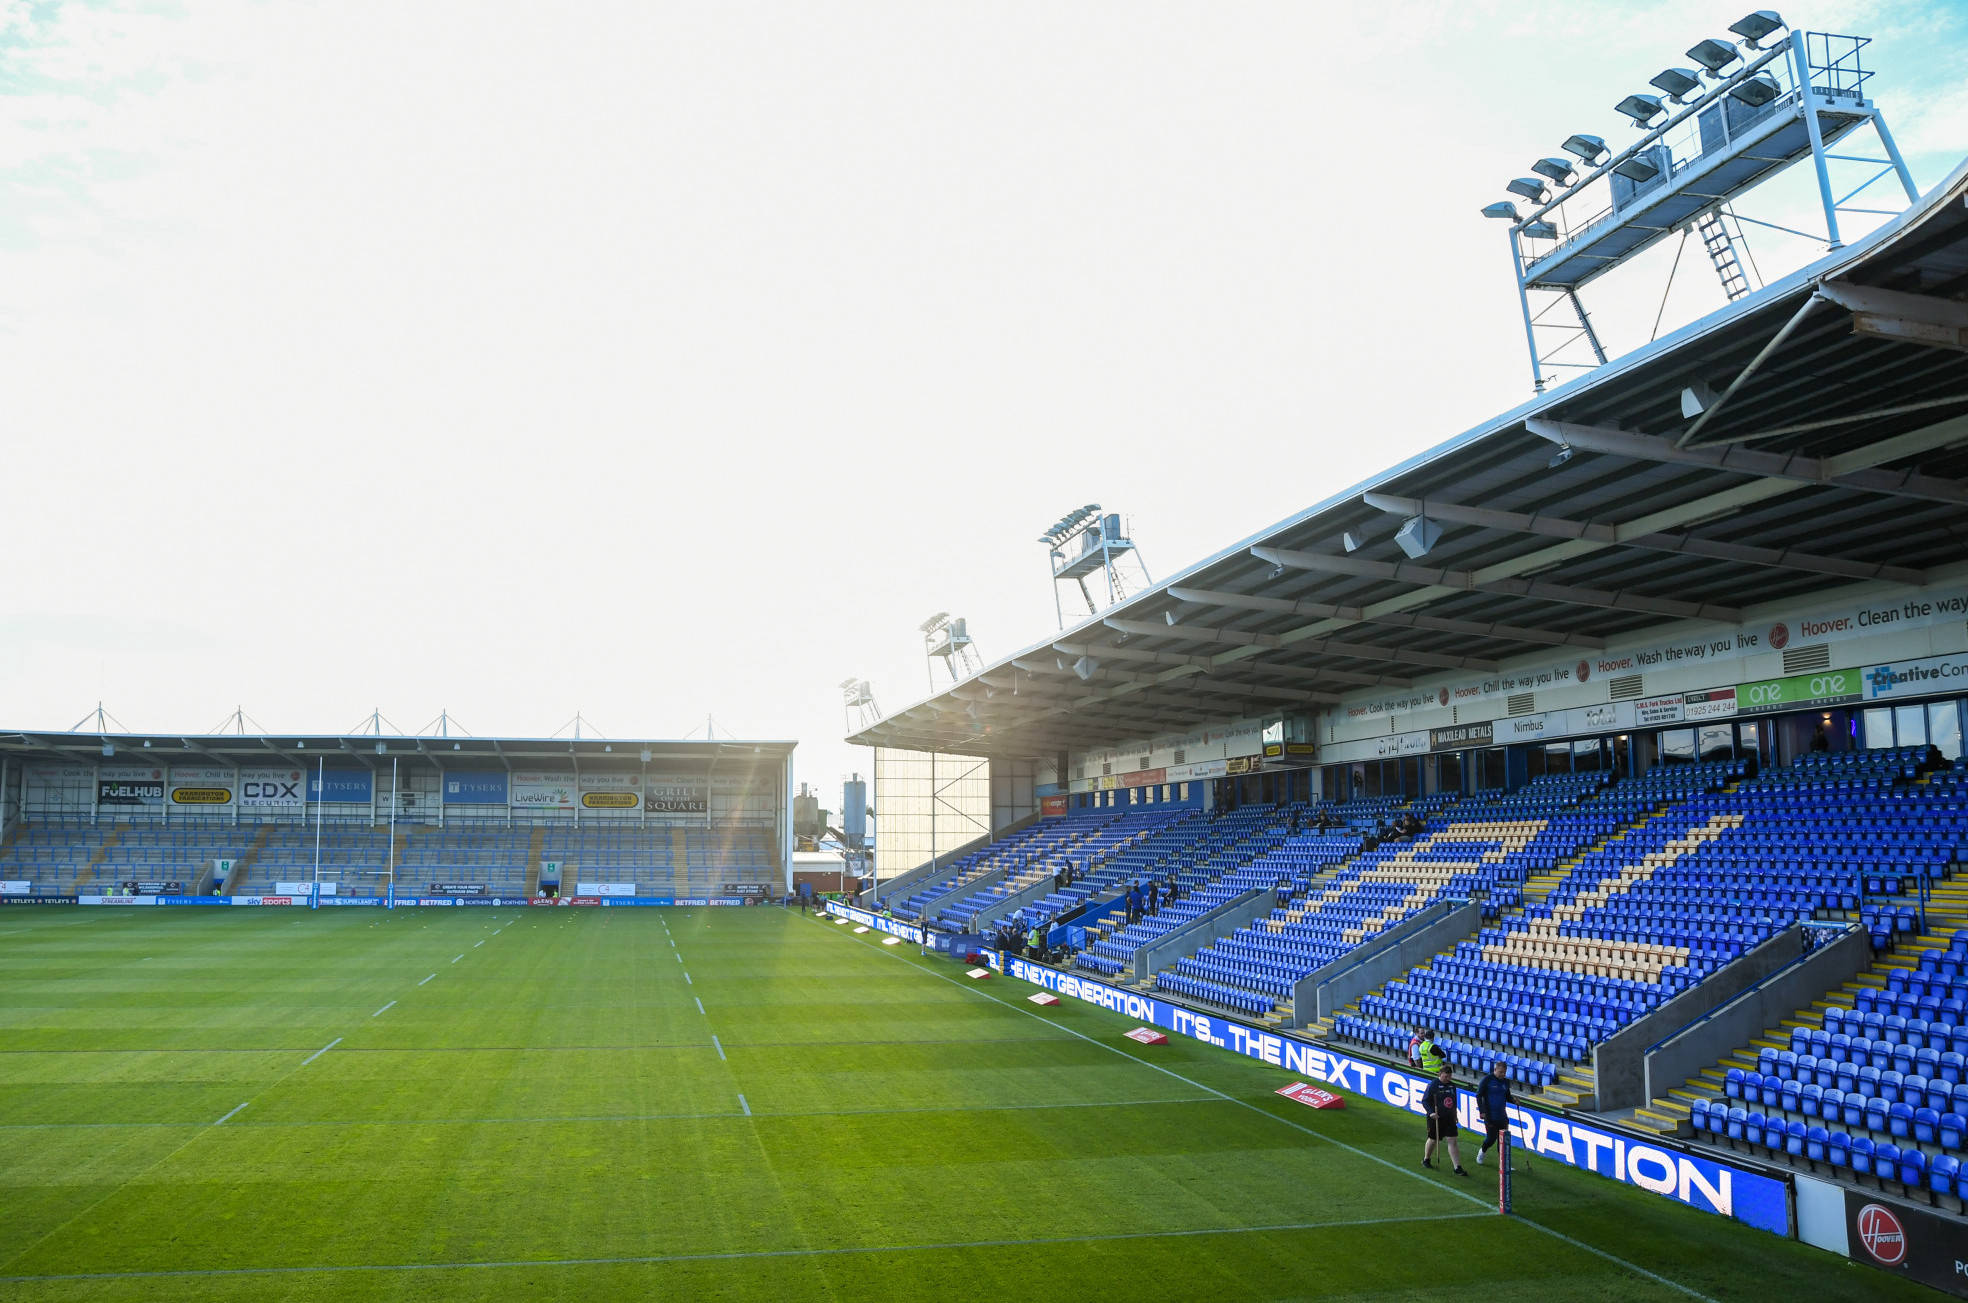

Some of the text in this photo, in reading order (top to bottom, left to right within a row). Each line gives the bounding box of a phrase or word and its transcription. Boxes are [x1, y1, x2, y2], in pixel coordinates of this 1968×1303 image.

[1801, 617, 1854, 637] Hoover.
[1858, 608, 1900, 626] Clean
[1904, 602, 1931, 619] the
[1936, 597, 1968, 614] way
[1598, 658, 1633, 673] Hoover.
[1636, 649, 1663, 665] Wash
[1666, 647, 1683, 661] the
[1684, 644, 1706, 659] way
[1710, 639, 1731, 656] you
[1737, 633, 1758, 649] live
[1455, 686, 1481, 698] Hoover.
[1483, 680, 1500, 694] Chill
[1502, 678, 1515, 690] the
[1519, 676, 1533, 689] way
[1535, 673, 1552, 686] you
[1554, 668, 1569, 680] live
[1750, 675, 1846, 704] one one
[1369, 703, 1384, 714] Cook
[1385, 701, 1395, 711] the
[1409, 698, 1421, 709] you
[1422, 693, 1434, 704] live
[1686, 705, 1707, 717] 01925
[1707, 704, 1721, 714] 244
[1722, 702, 1736, 712] 244
[1469, 725, 1492, 739] METALS
[1514, 720, 1544, 733] Nimbus
[205, 770, 221, 778] Chill
[101, 785, 163, 797] FUELHUB
[243, 782, 299, 798] CDX
[326, 782, 368, 791] TYSERS
[464, 783, 503, 791] TYSERS
[514, 791, 556, 803] LiveWire
[647, 801, 706, 812] SQUARE
[247, 897, 292, 906] sky sports
[1024, 963, 1057, 990] NEXT
[1057, 973, 1154, 1024] GENERATION
[1172, 1008, 1225, 1047] IT'S...
[1228, 1025, 1282, 1065] THE
[1285, 1046, 1376, 1096] NEXT
